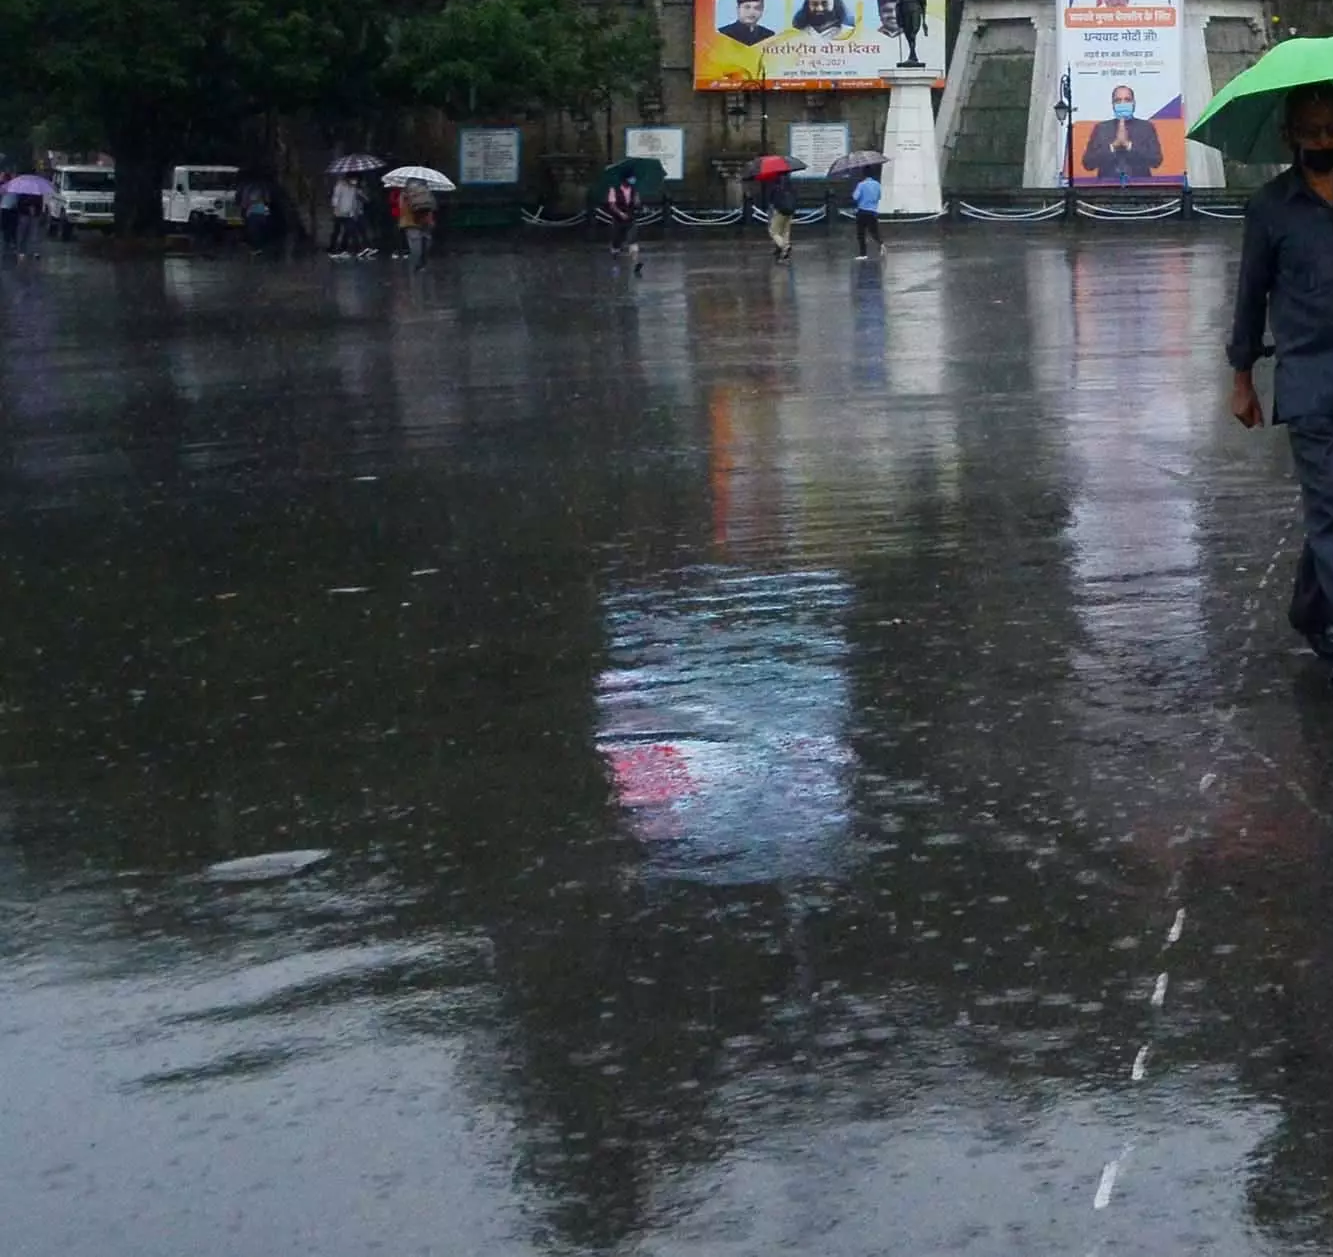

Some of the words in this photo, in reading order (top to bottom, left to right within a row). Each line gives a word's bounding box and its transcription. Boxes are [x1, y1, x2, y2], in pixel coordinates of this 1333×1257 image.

[1083, 31, 1119, 42] धन्यवाद
[1121, 29, 1141, 41] मोदी
[820, 42, 845, 54] योग
[848, 42, 881, 54] दिवस
